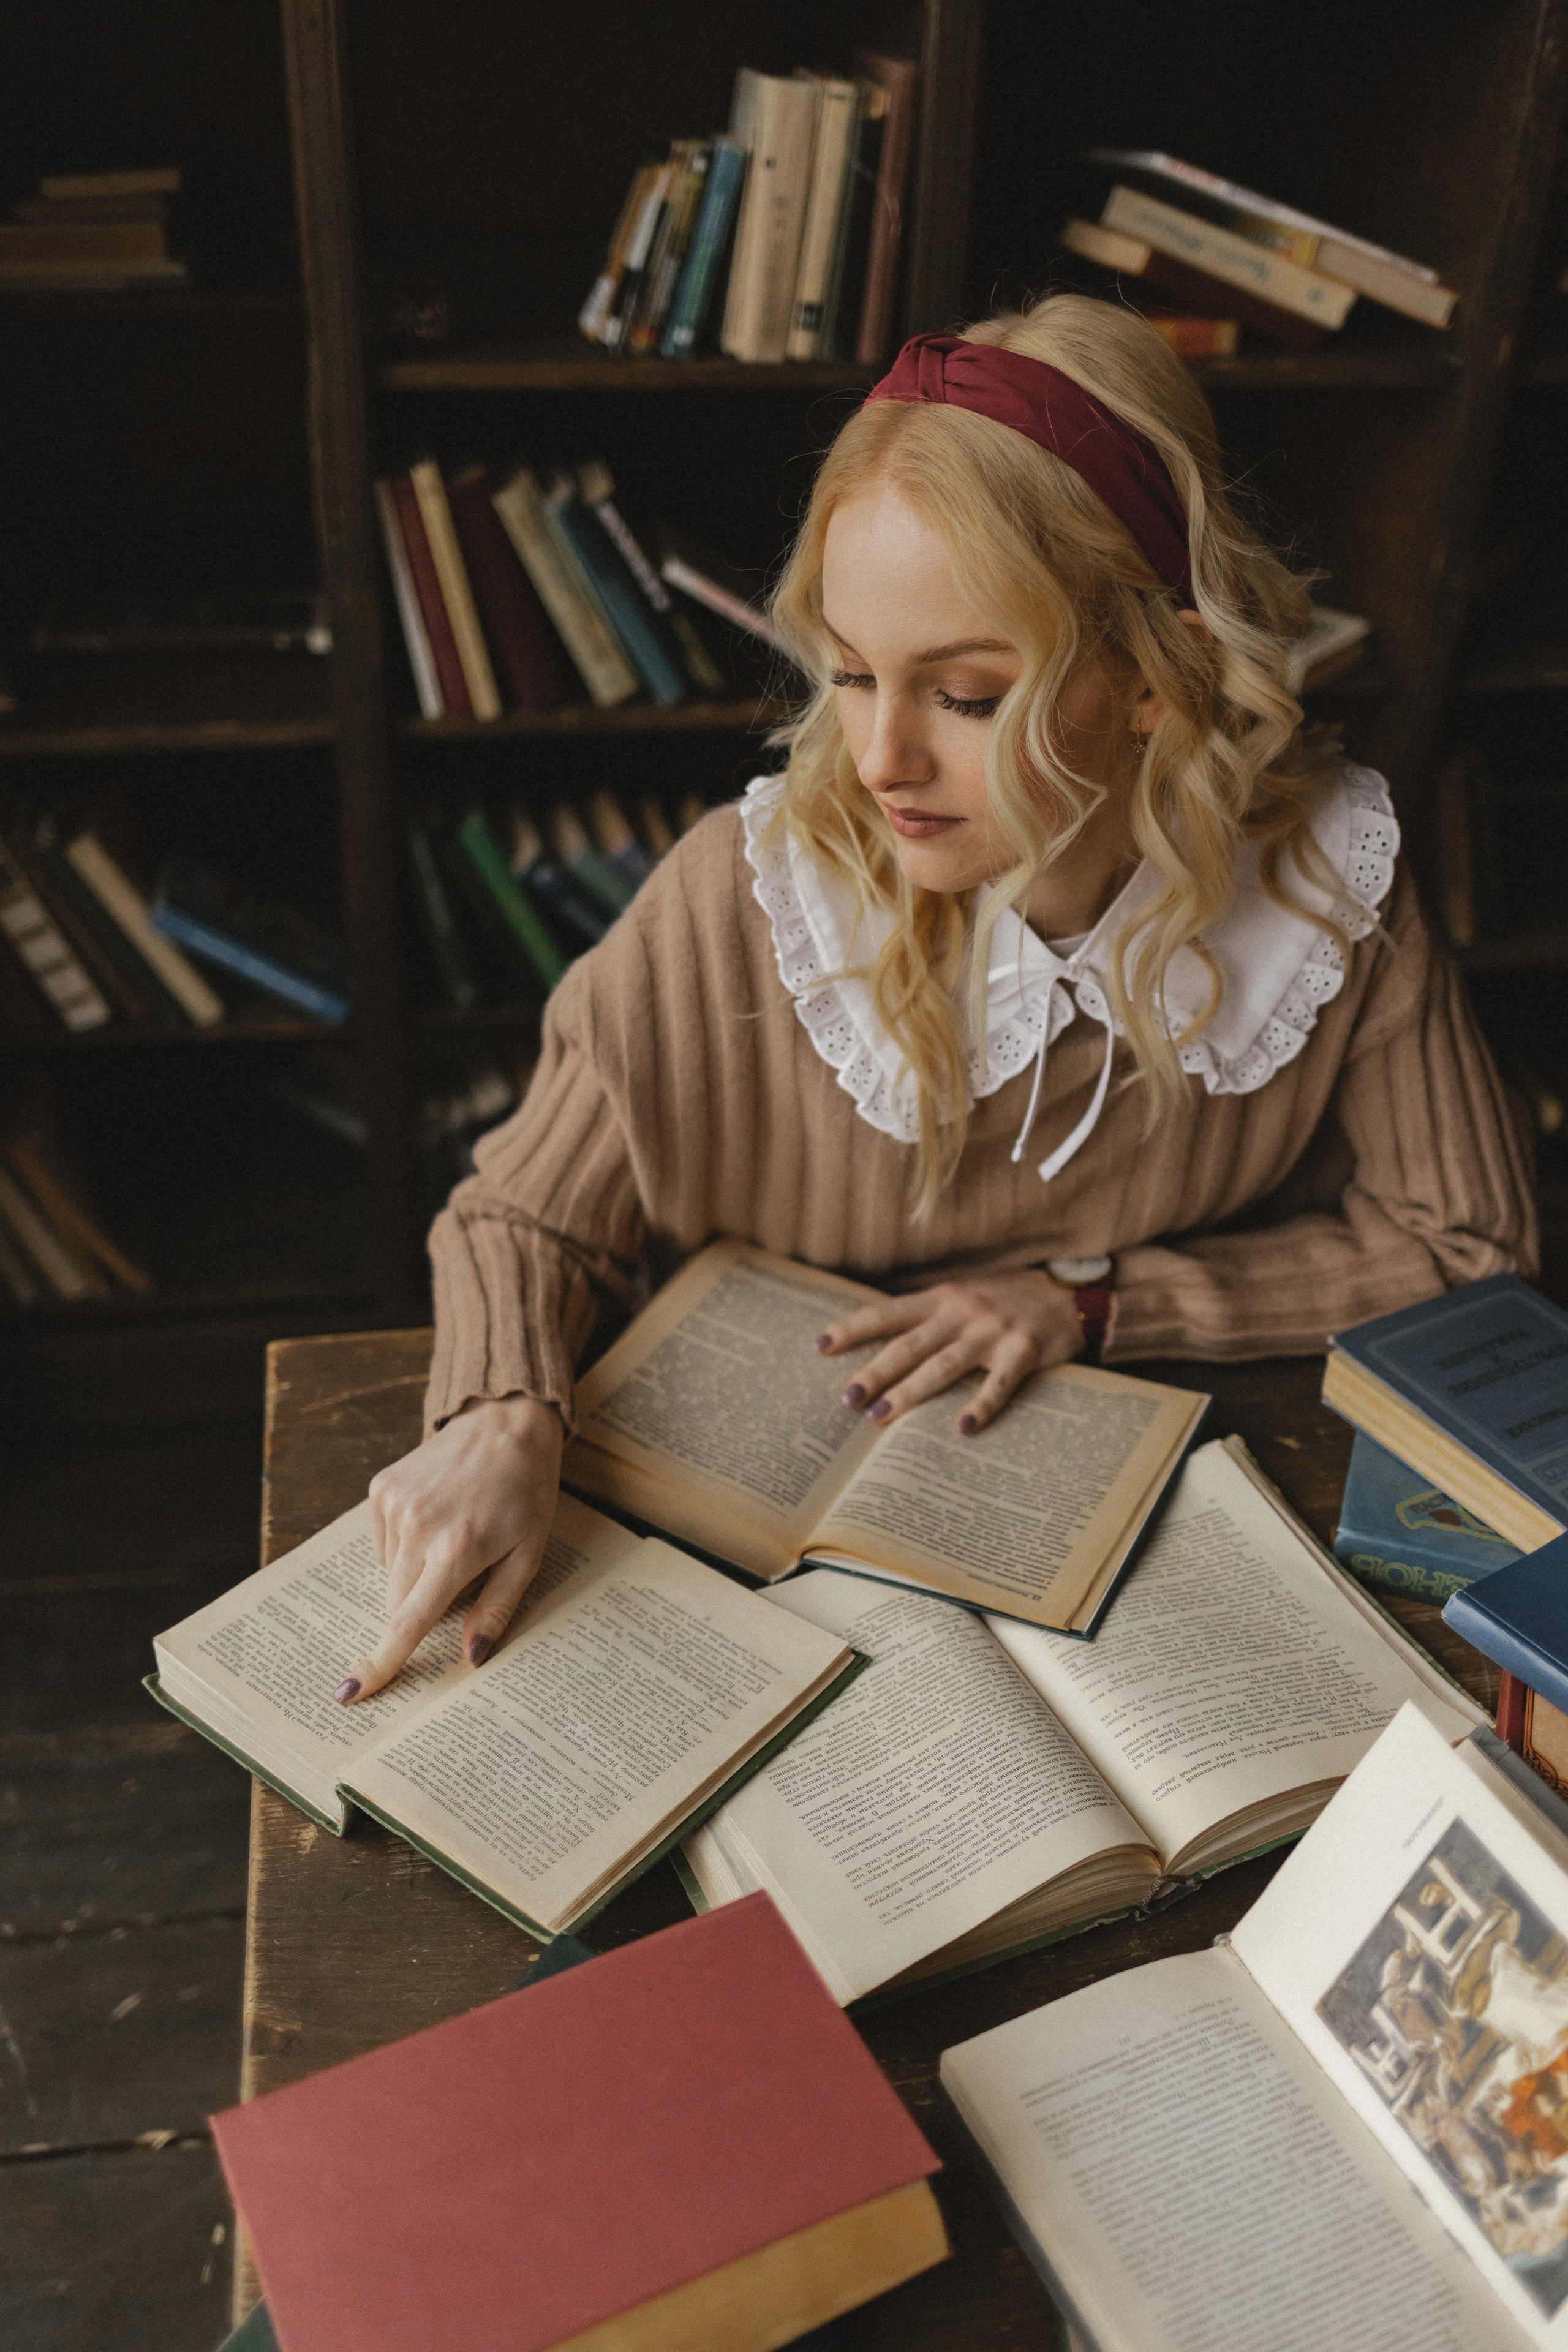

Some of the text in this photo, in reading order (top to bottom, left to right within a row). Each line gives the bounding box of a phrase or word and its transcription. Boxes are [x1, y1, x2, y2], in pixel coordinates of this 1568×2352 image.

[1153, 1726, 1180, 1741] Право,
[1185, 1724, 1207, 1733] когда
[1290, 1730, 1320, 1740] букетом
[1120, 1727, 1161, 1754] необъятной
[1144, 1736, 1173, 1754] впустят
[1178, 1731, 1210, 1746] какой-то
[1237, 1744, 1256, 1752] руке,
[1264, 1736, 1289, 1745] цветов
[1272, 1739, 1305, 1751] картиной
[403, 1747, 428, 1763] степной
[510, 1714, 617, 1798] Заметив его волнение, спохватился
[1125, 1738, 1154, 1759] хорошо!
[1129, 1751, 1144, 1764] под-
[1155, 1742, 1178, 1757] особе,
[1182, 1740, 1227, 1760] Николаевич.
[1213, 1750, 1235, 1760] перед
[1240, 1747, 1272, 1760] Нилуса,
[413, 1762, 431, 1775] себе.
[431, 1754, 464, 1778] молодость,
[475, 1757, 500, 1776] жаркие
[1142, 1754, 1155, 1764] что
[1177, 1758, 1213, 1778] закрытой
[426, 1760, 453, 1781] далекий
[1184, 1757, 1238, 1784] изображавшей
[407, 1765, 448, 1797] почувствовал,
[407, 1775, 429, 1792] сердце
[436, 1777, 462, 1798] жалость
[462, 1776, 483, 1793] дымке
[499, 1776, 521, 1793] глазах
[593, 1769, 634, 1801] Михайлович:
[1040, 1784, 1061, 1796] через
[1060, 1778, 1093, 1788] учащихся
[1150, 1776, 1176, 1795] дверью
[460, 1785, 478, 1800] ушла
[1155, 1782, 1182, 1802] старого
[426, 1790, 462, 1819] резнувшего
[447, 1796, 467, 1812] вдруг
[477, 1799, 491, 1811] уже
[480, 1793, 507, 1814] голубой
[529, 1800, 554, 1820] ощутил
[994, 1795, 1042, 1824] ознакомление
[1064, 1795, 1109, 1809] современного
[1070, 1801, 1108, 1815] выражения
[461, 1798, 502, 1830] нестерпимую
[843, 1755, 1068, 1877] художественной культурой прошлого, чтобы обогатить свой язык
[1019, 1807, 1065, 1835] образования
[1027, 1805, 1053, 1820] сможет
[1049, 1812, 1070, 1825] своих
[461, 1819, 489, 1842] внезапно
[472, 1816, 496, 1835] матери
[488, 1809, 534, 1846] действительно
[511, 1816, 540, 1839] потонула
[554, 1820, 582, 1844] Николай
[847, 1764, 1058, 1883] осознав достижения прошлых веков. Художник должен про-
[992, 1819, 1025, 1842] выразить
[1030, 1823, 1049, 1837] идей
[493, 1835, 524, 1860] покойной
[501, 1829, 527, 1850] детстве,
[540, 1839, 564, 1858] ризонт,
[867, 1785, 1084, 1907] ставит своей задачей поднятие художественной культуры
[945, 1833, 979, 1855] великими
[982, 1837, 1011, 1857] владеть
[994, 1834, 1030, 1858] художник
[533, 1845, 545, 1855] что
[962, 1842, 993, 1863] никакой
[530, 1864, 544, 1875] ния
[532, 1854, 551, 1870] да-то
[899, 1853, 945, 1882] памятниками
[941, 1860, 961, 1874] идеи.
[949, 1857, 982, 1880] техникой
[967, 1857, 994, 1877] должен
[515, 1863, 538, 1882] брата,
[862, 1880, 899, 1901] искусства
[925, 1878, 949, 1894] своего
[925, 1875, 967, 1902] находиться
[892, 1891, 923, 1912] ремесла,
[882, 1907, 914, 1926] высоком
